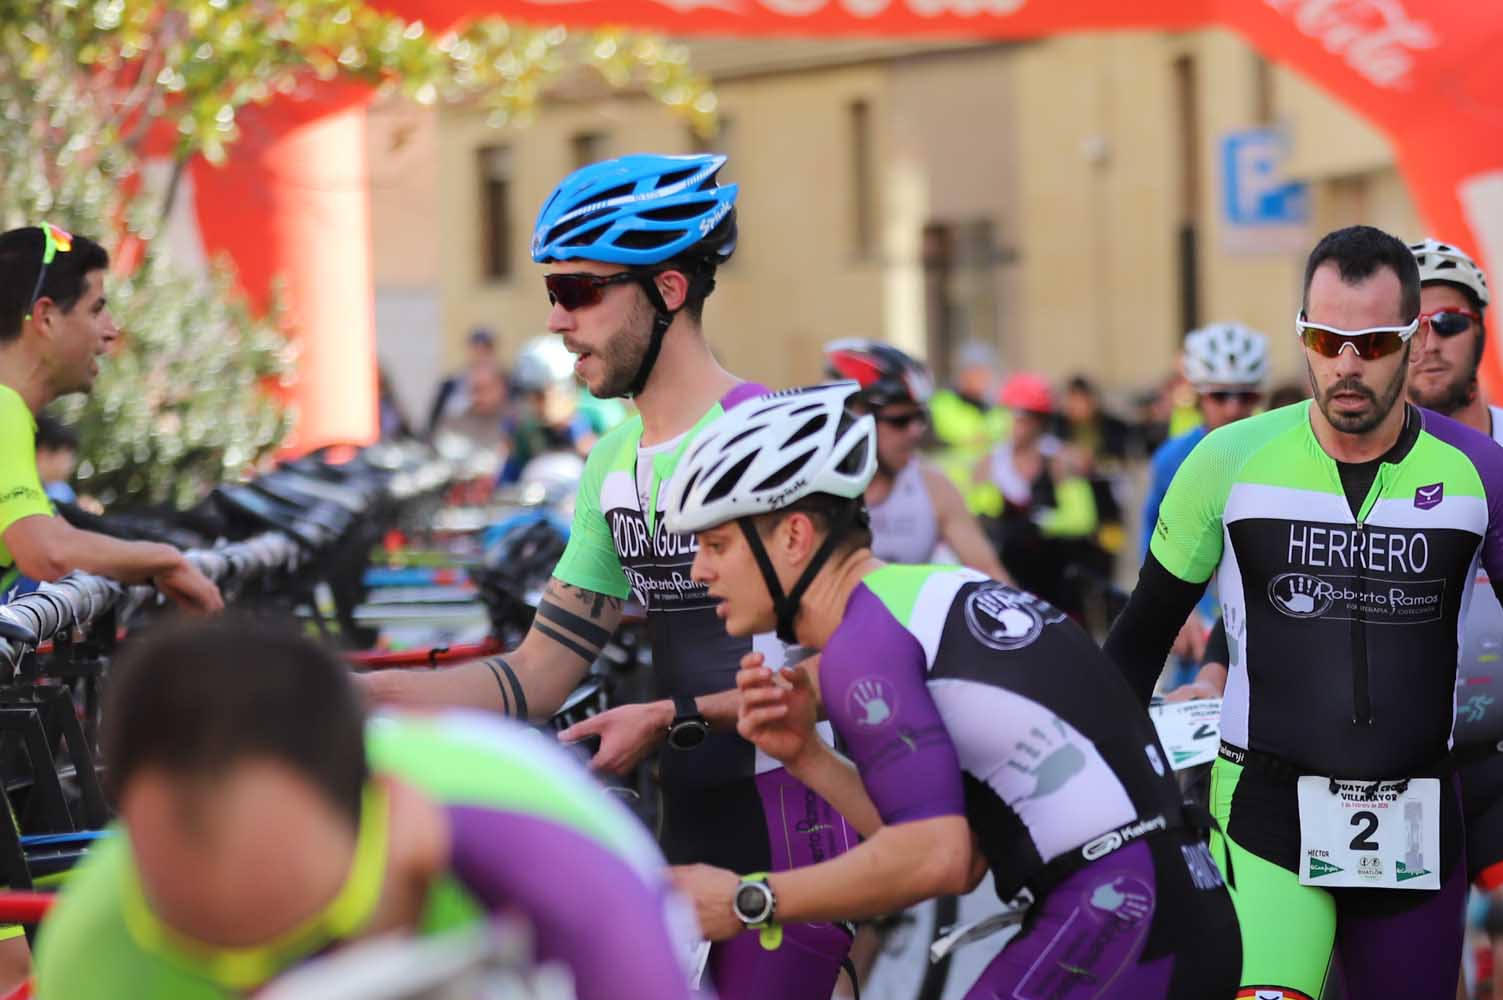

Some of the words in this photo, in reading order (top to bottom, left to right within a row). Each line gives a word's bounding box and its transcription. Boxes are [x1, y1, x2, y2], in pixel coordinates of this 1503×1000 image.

[1288, 523, 1429, 574] HERRERO
[1317, 582, 1387, 605] Roberto
[1389, 588, 1439, 607] Ramos
[1340, 792, 1398, 802] VILLAMAYOR
[1349, 811, 1379, 851] 2
